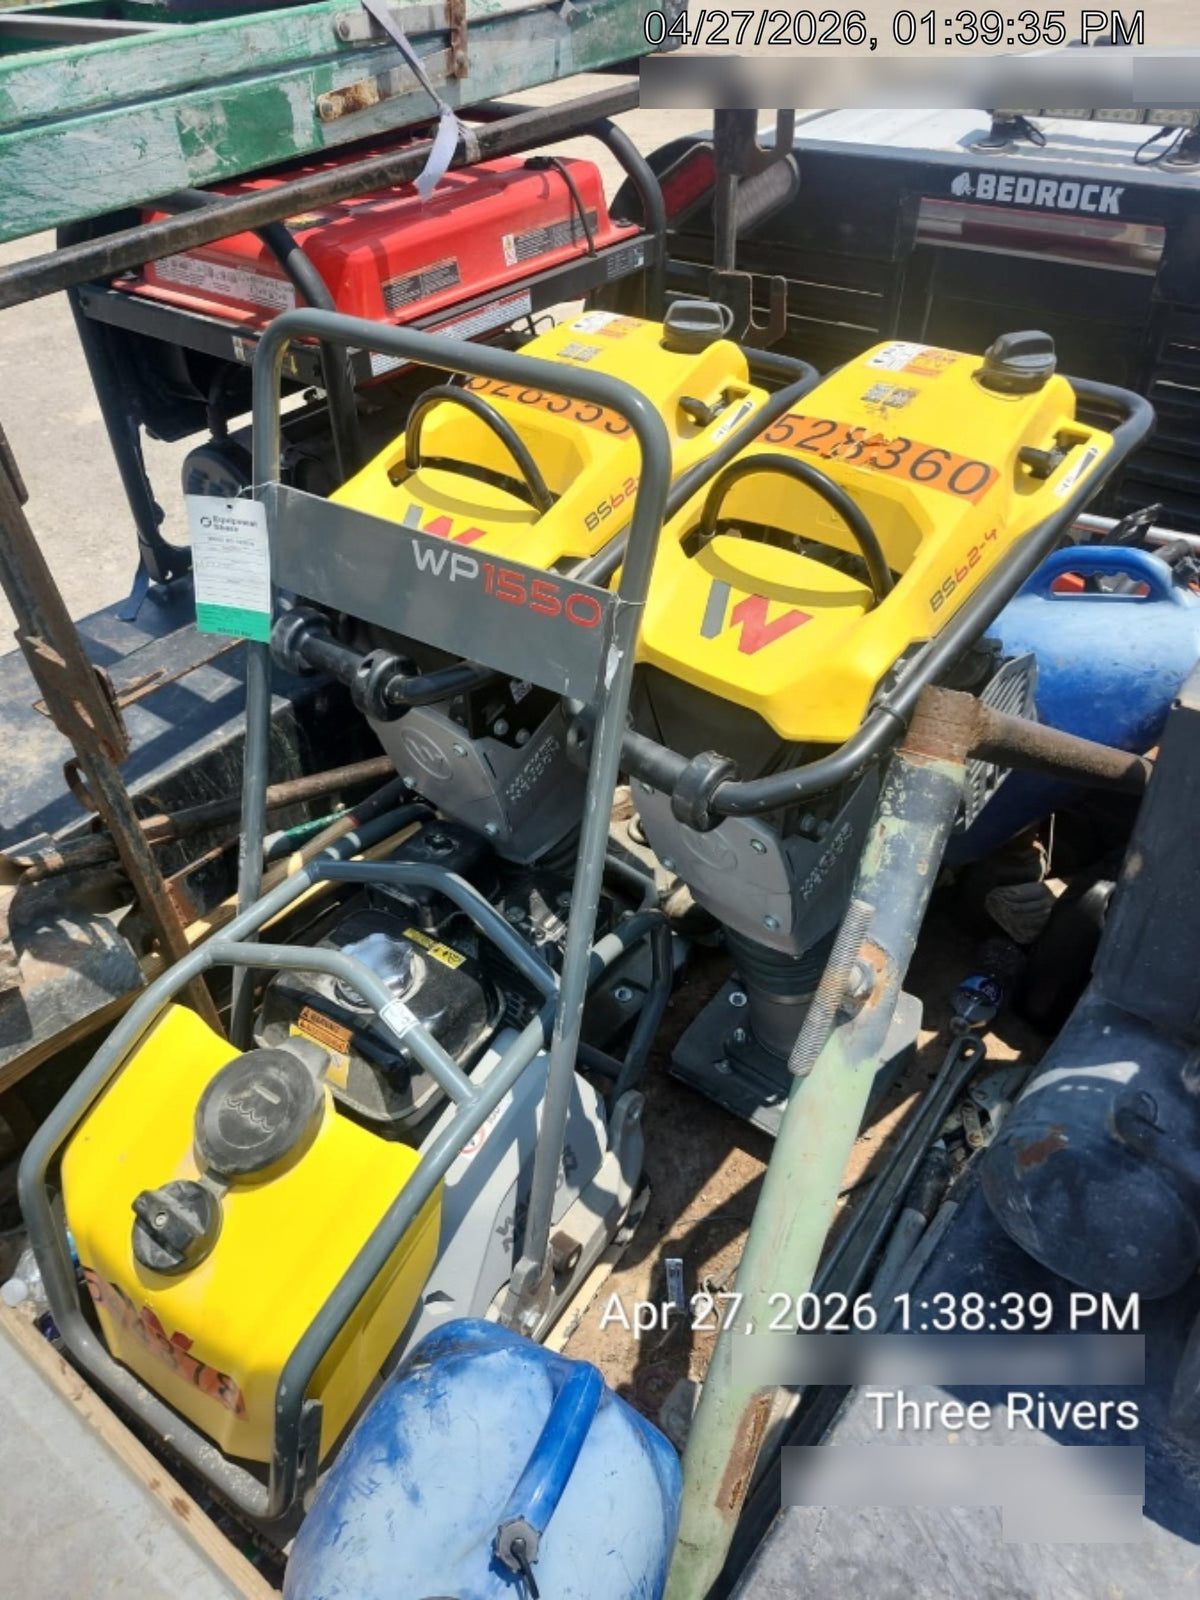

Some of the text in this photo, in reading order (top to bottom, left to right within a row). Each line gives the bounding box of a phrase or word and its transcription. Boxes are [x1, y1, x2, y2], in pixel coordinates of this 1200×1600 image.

[976, 173, 1126, 214] BEDROCK
[584, 476, 639, 531] BS62
[411, 539, 602, 628] WP1550
[929, 528, 997, 614] BS62-4
